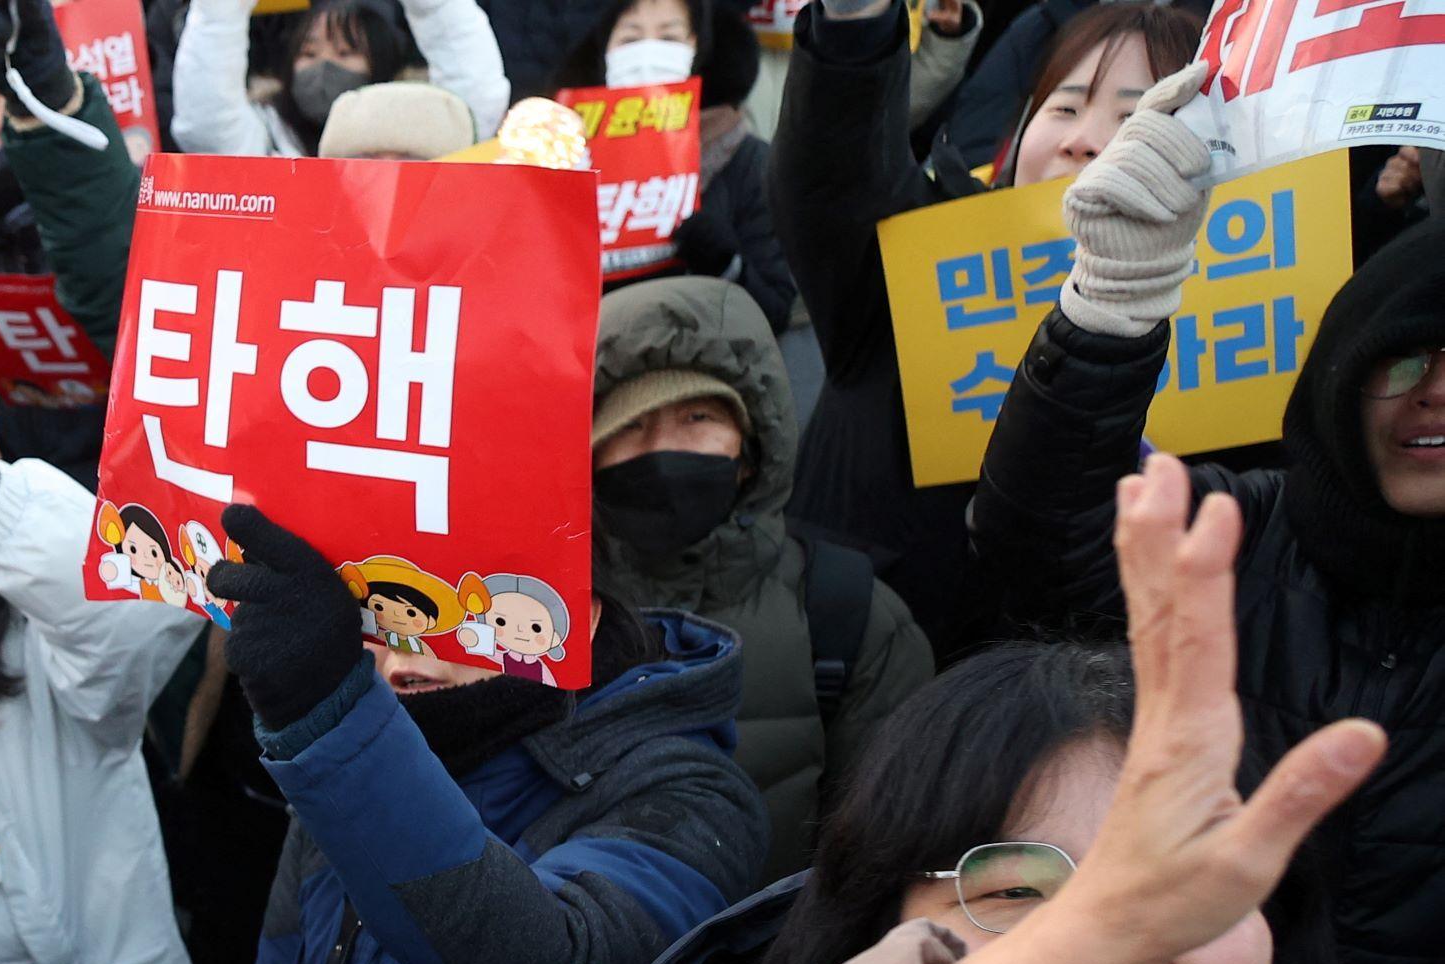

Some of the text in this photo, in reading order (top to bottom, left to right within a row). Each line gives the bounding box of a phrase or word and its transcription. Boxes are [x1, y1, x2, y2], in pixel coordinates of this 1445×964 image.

[1347, 123, 1393, 135] 카카오뱅크
[154, 190, 275, 213] www.nanum.com
[133, 269, 462, 536] 탄핵
